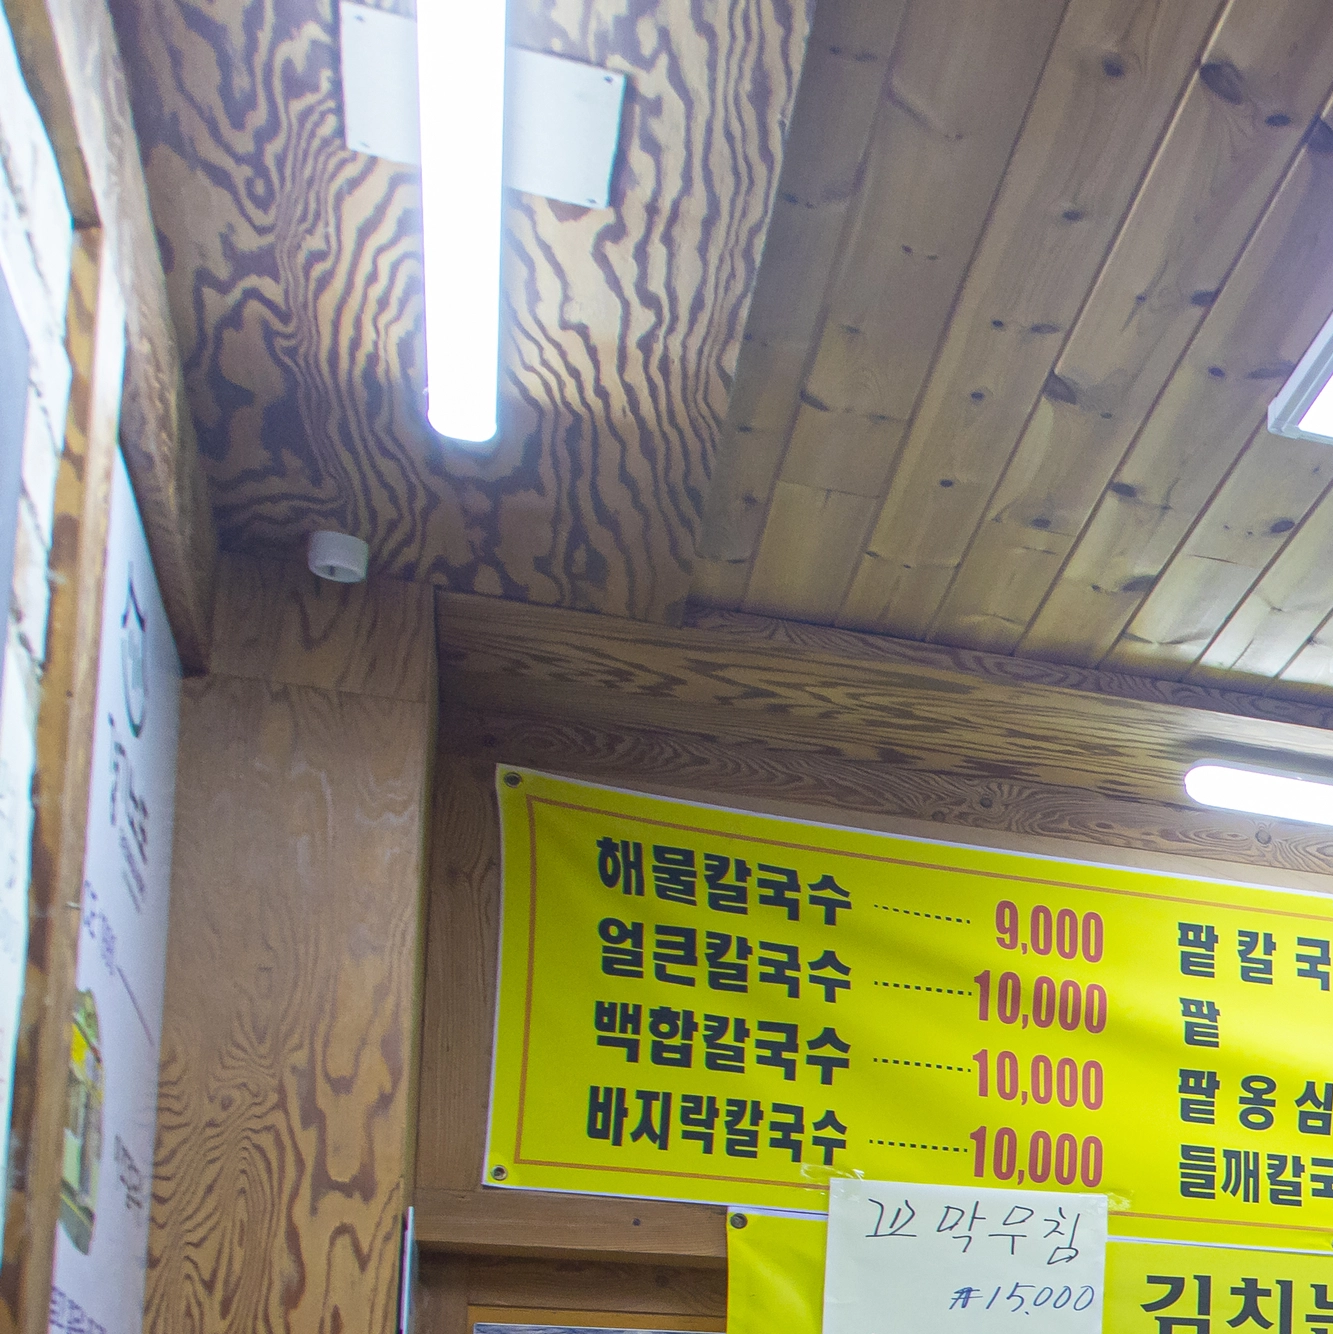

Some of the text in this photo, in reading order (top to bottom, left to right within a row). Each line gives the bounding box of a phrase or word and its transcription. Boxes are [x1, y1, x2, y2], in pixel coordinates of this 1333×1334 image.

[597, 834, 1103, 963] 해물칼국수 9,000
[596, 915, 1107, 1033] 얼큰칼국수 10,000
[592, 998, 1103, 1110] 백합칼국수 10,000
[583, 1083, 1103, 1188] 바지락칼국수 10,000
[866, 1199, 1080, 1265] 꼬막무침
